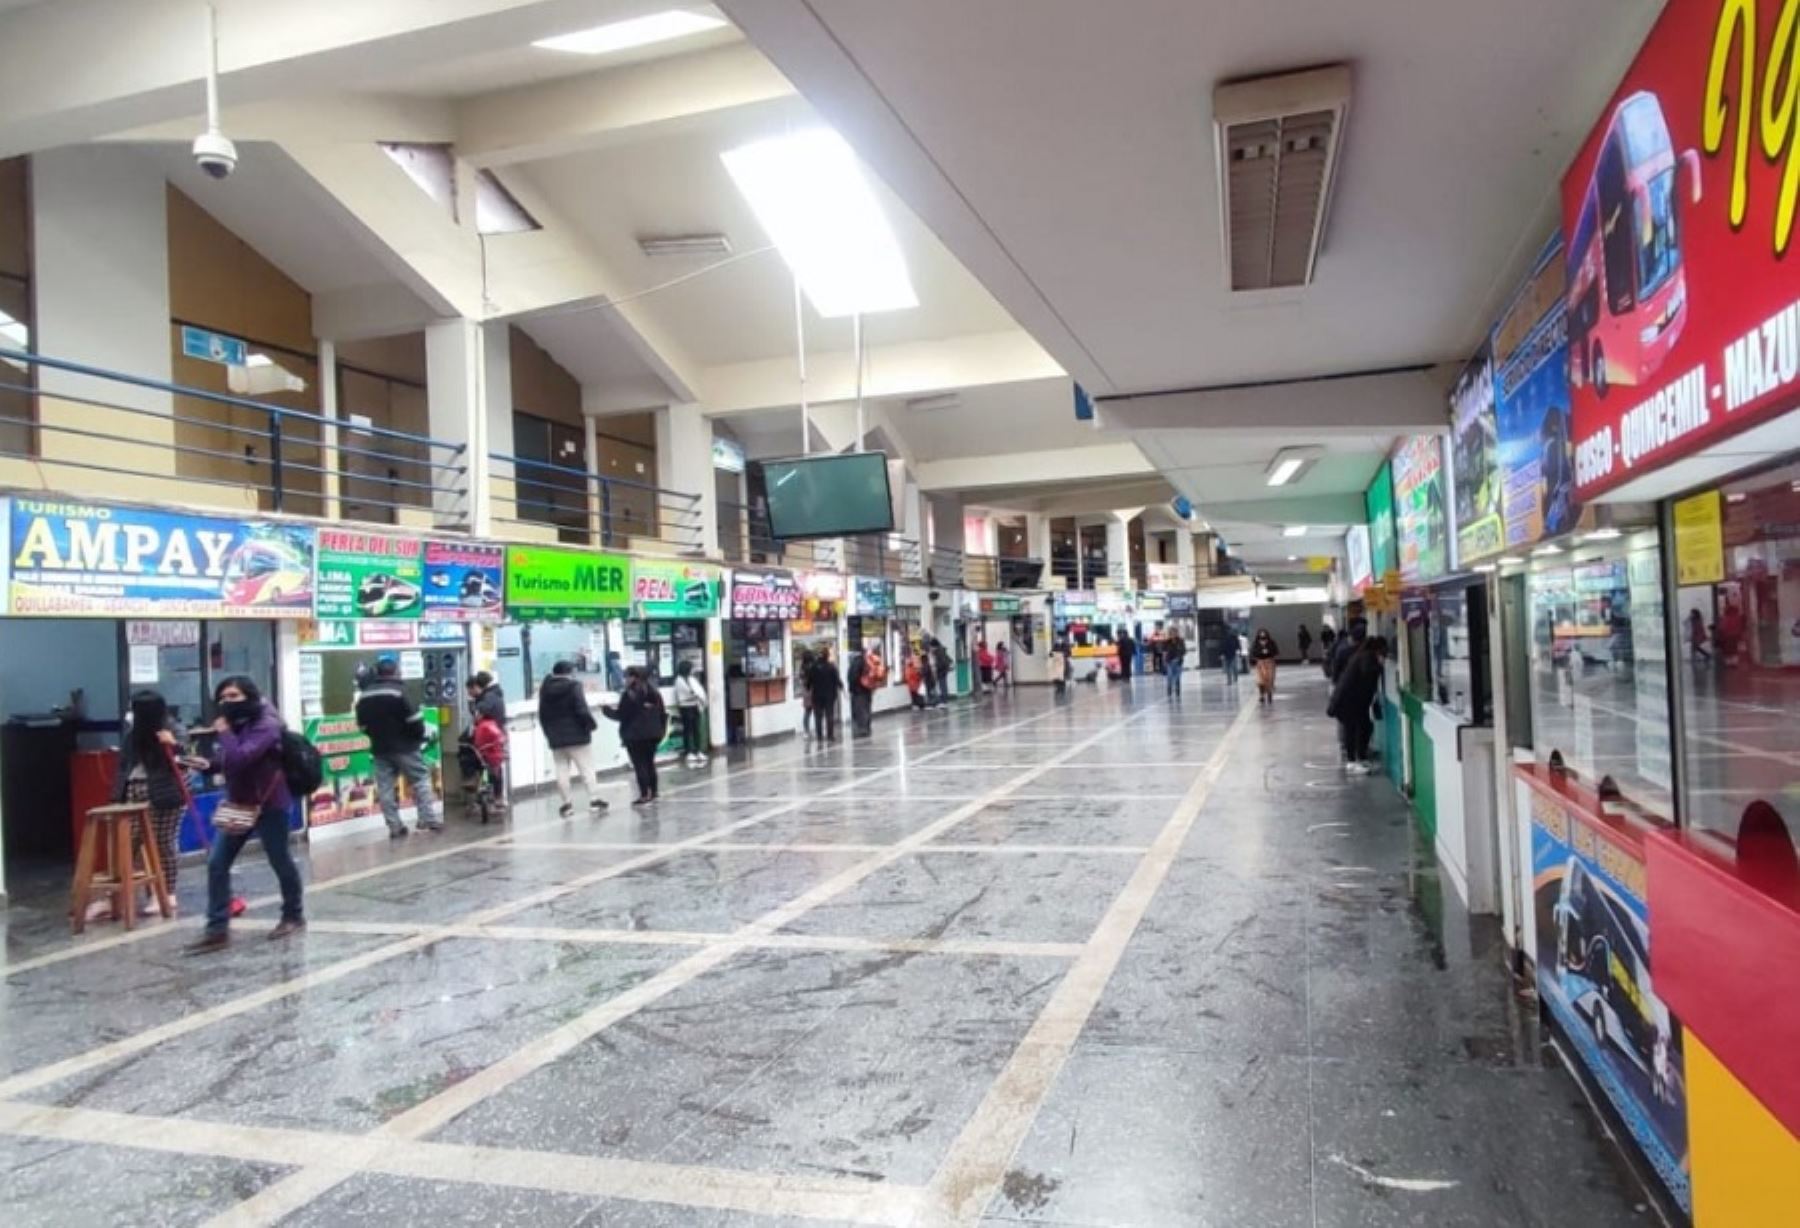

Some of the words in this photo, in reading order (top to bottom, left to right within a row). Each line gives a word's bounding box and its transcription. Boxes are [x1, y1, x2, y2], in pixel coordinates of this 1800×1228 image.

[1575, 424, 1612, 488] CUSCO
[1620, 363, 1710, 468] QUINCEMIL
[1723, 298, 1800, 412] MAZU
[17, 500, 112, 520] TURISMO
[15, 517, 233, 575] AMPAY
[320, 531, 365, 553] PERLA
[368, 535, 391, 556] DEL
[394, 539, 420, 557] SUR
[515, 573, 570, 591] Turismo
[573, 564, 624, 593] MER
[634, 577, 677, 599] REAL
